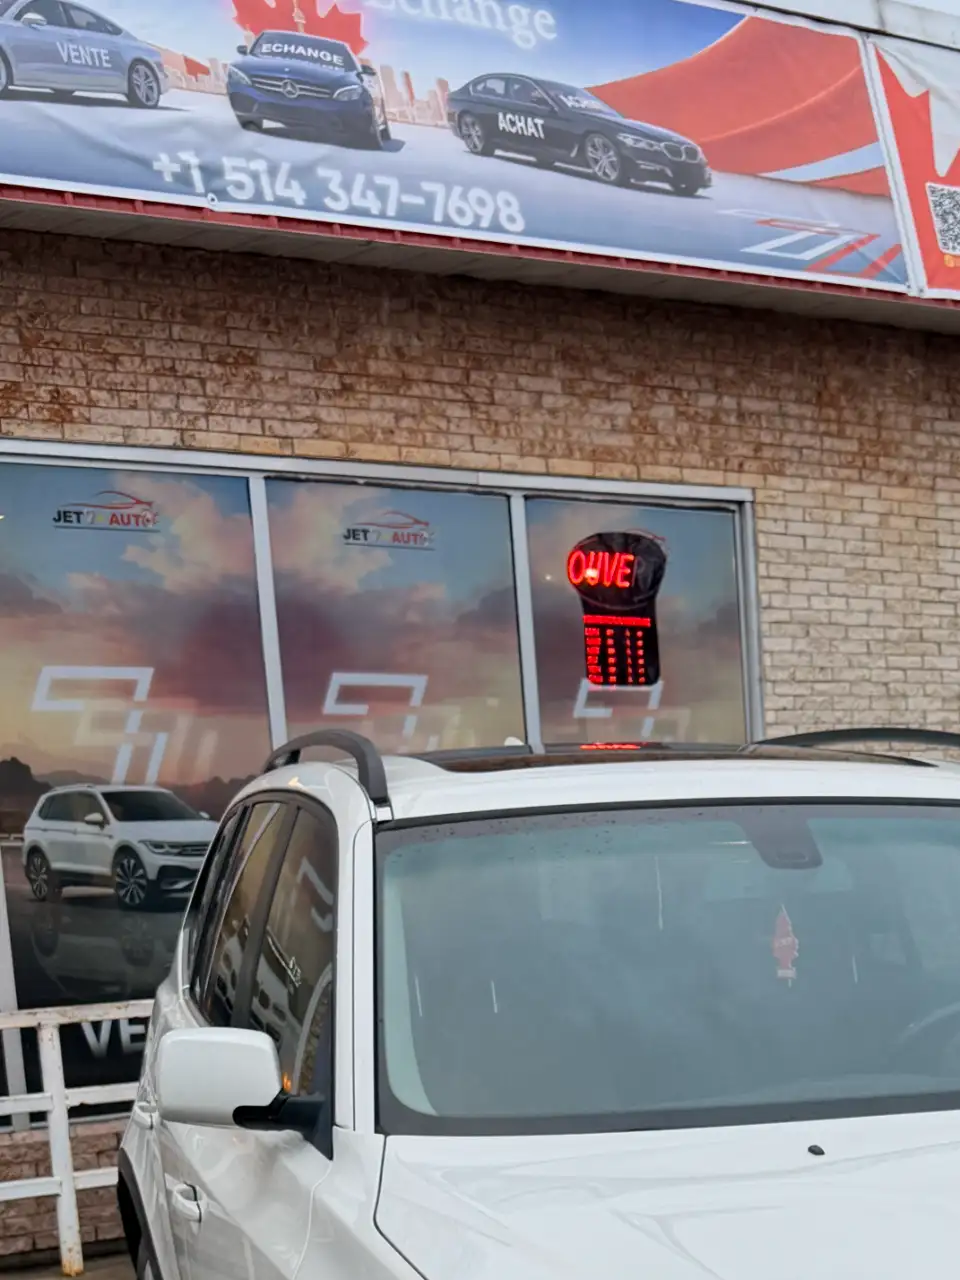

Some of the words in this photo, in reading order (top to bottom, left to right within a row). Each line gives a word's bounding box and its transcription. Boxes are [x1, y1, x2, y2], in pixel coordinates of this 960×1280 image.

[366, 0, 558, 50] change
[56, 41, 112, 68] VENTE
[261, 43, 345, 66] ECHANGE
[498, 112, 546, 140] ACHAT
[153, 151, 206, 194] +1
[222, 157, 306, 206] 514
[316, 167, 526, 234] 347-7698
